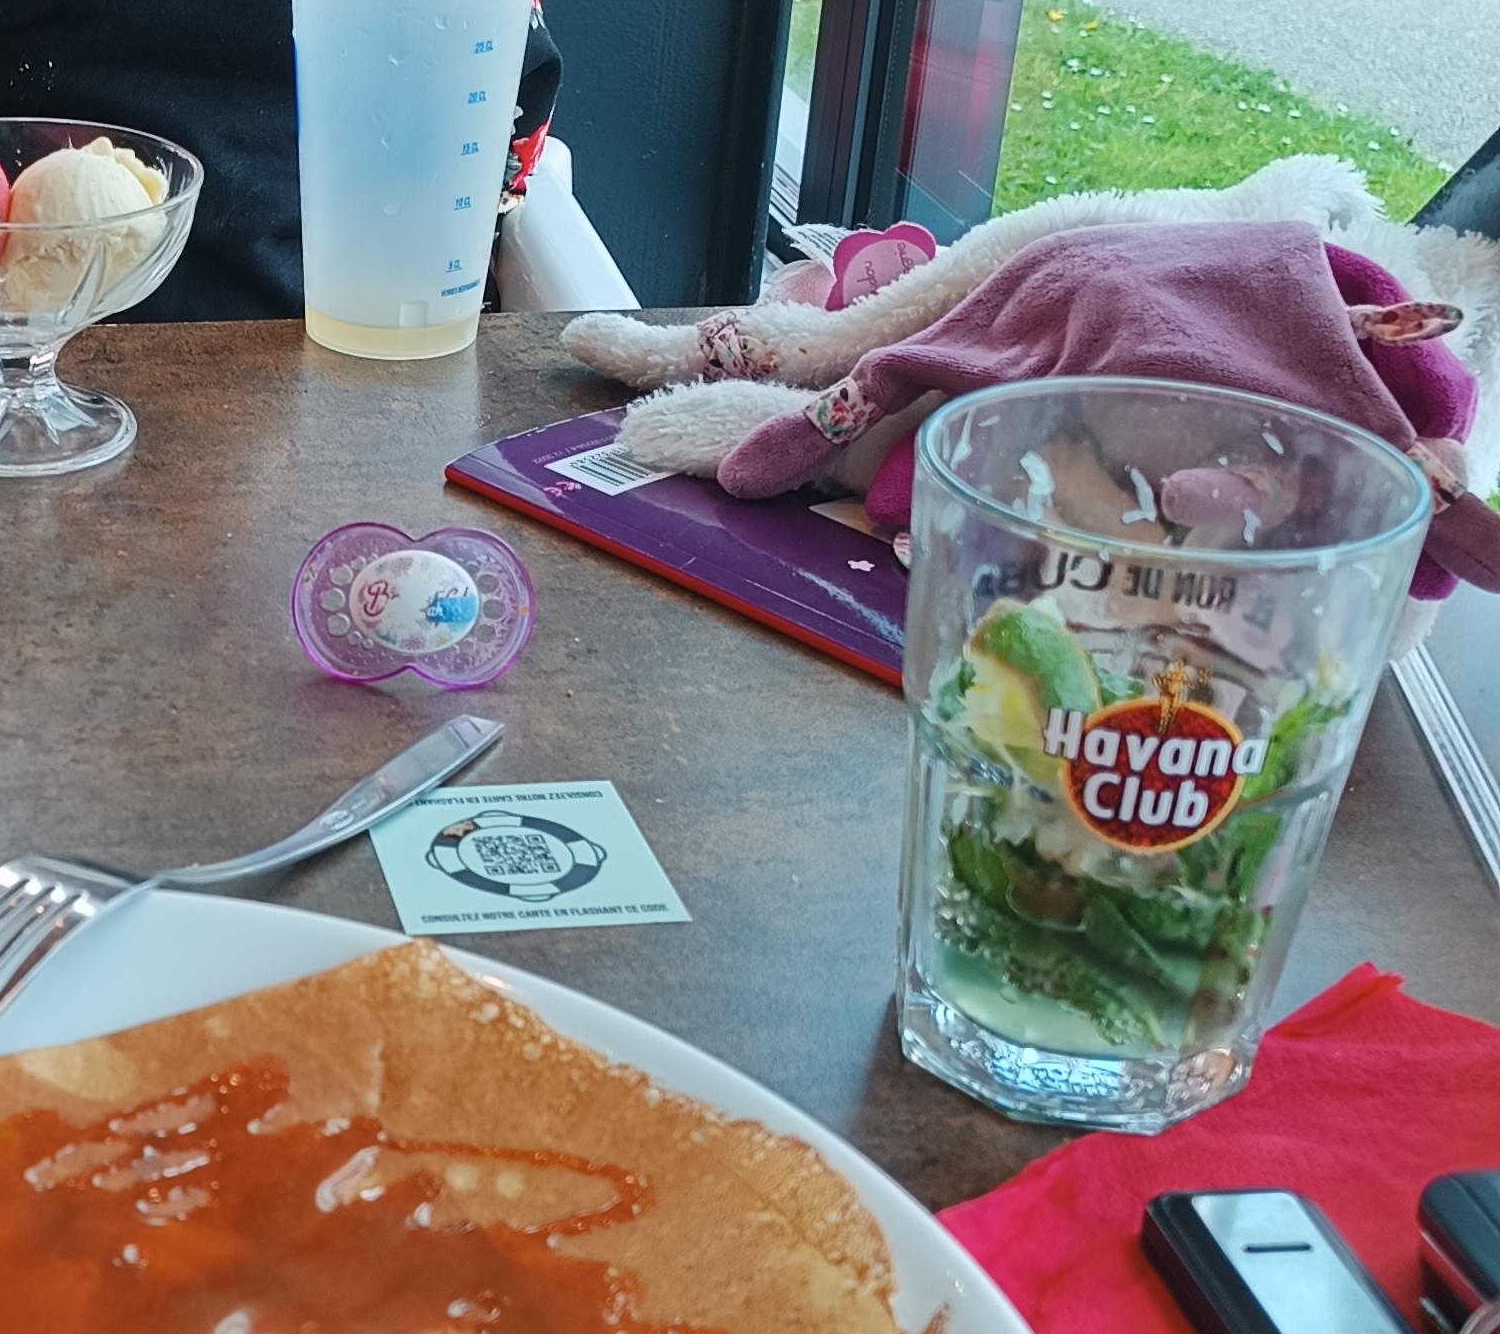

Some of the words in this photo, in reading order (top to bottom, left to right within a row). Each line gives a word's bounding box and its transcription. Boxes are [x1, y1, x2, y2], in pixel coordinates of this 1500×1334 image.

[1044, 707, 1269, 778] Havana
[1083, 772, 1208, 828] Club
[421, 913, 480, 924] CONSULTEZ
[482, 911, 516, 922] NOTRE
[518, 909, 551, 920] CARTE
[553, 908, 569, 918] EN
